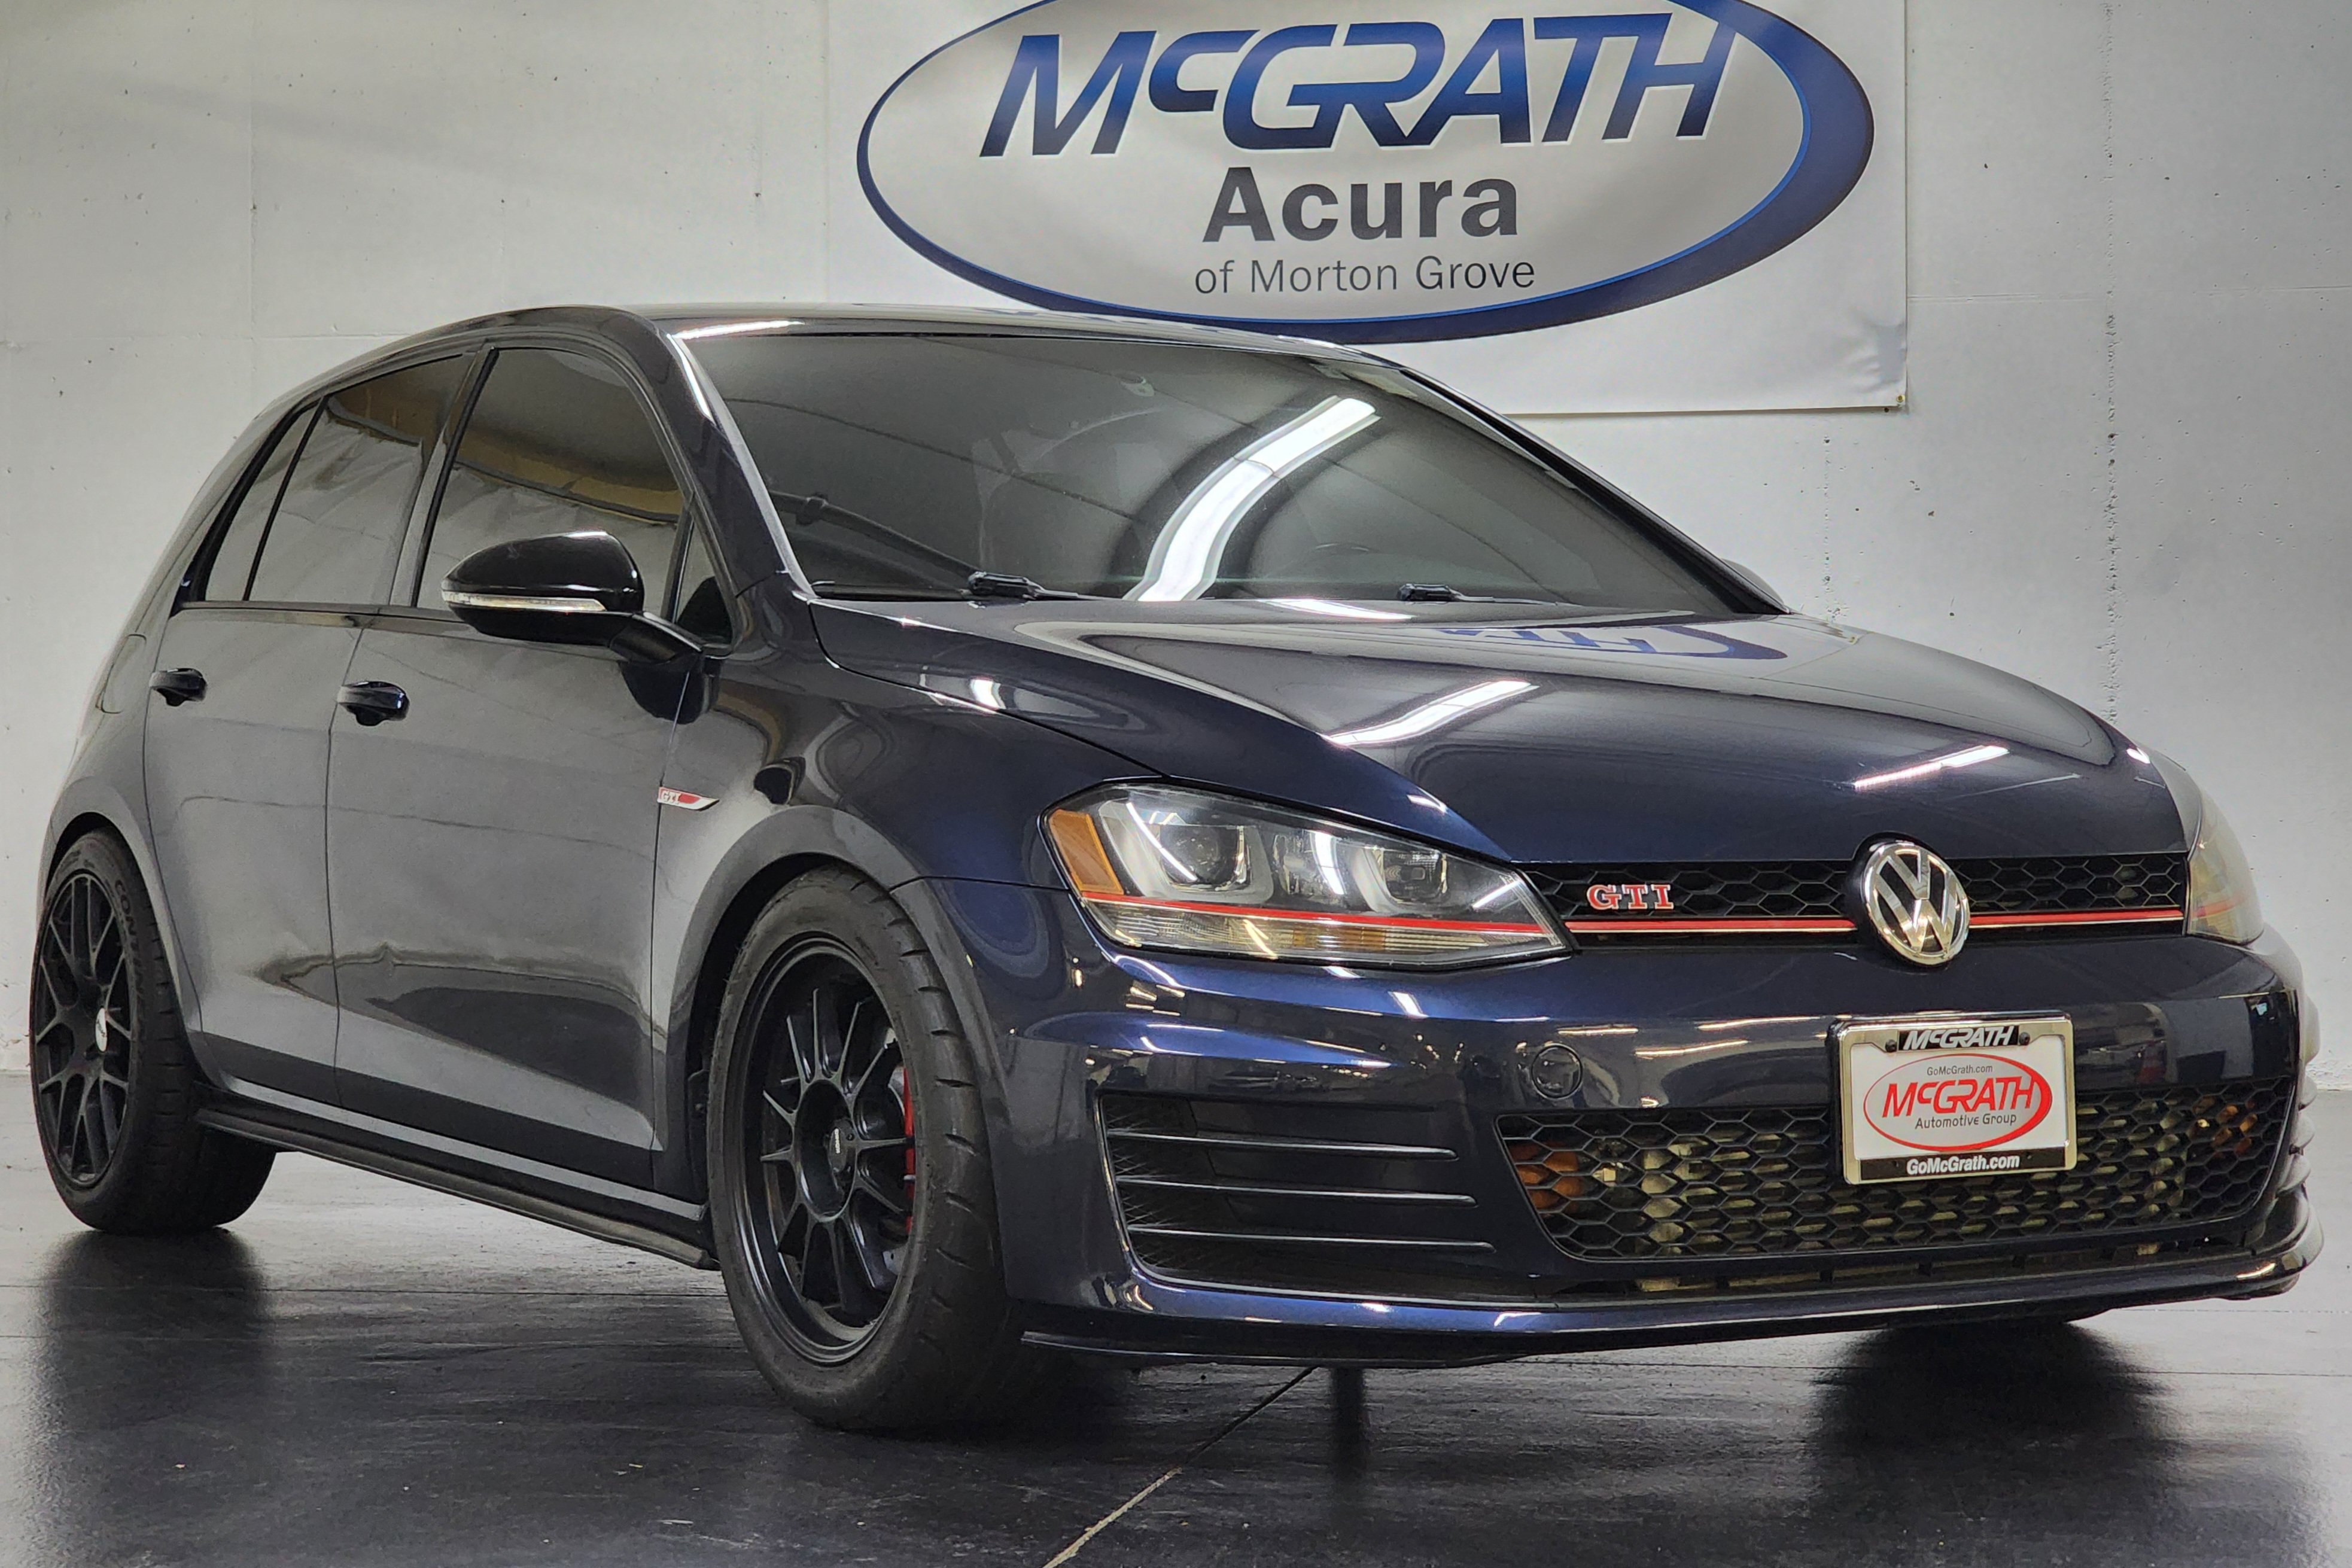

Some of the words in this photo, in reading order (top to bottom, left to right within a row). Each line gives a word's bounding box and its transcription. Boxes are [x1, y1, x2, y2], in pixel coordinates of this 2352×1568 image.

[1202, 166, 1518, 242] Acura
[1195, 259, 1235, 294] of
[1250, 259, 1398, 293] Morton
[1416, 255, 1535, 290] Grove
[1586, 884, 1674, 911] GTI
[1927, 1065, 1993, 1076] GoMcGrath.com
[1915, 1115, 1979, 1129] Automotive
[1983, 1113, 2017, 1126] Group
[1906, 1154, 2020, 1176] GoMcGrath.com
